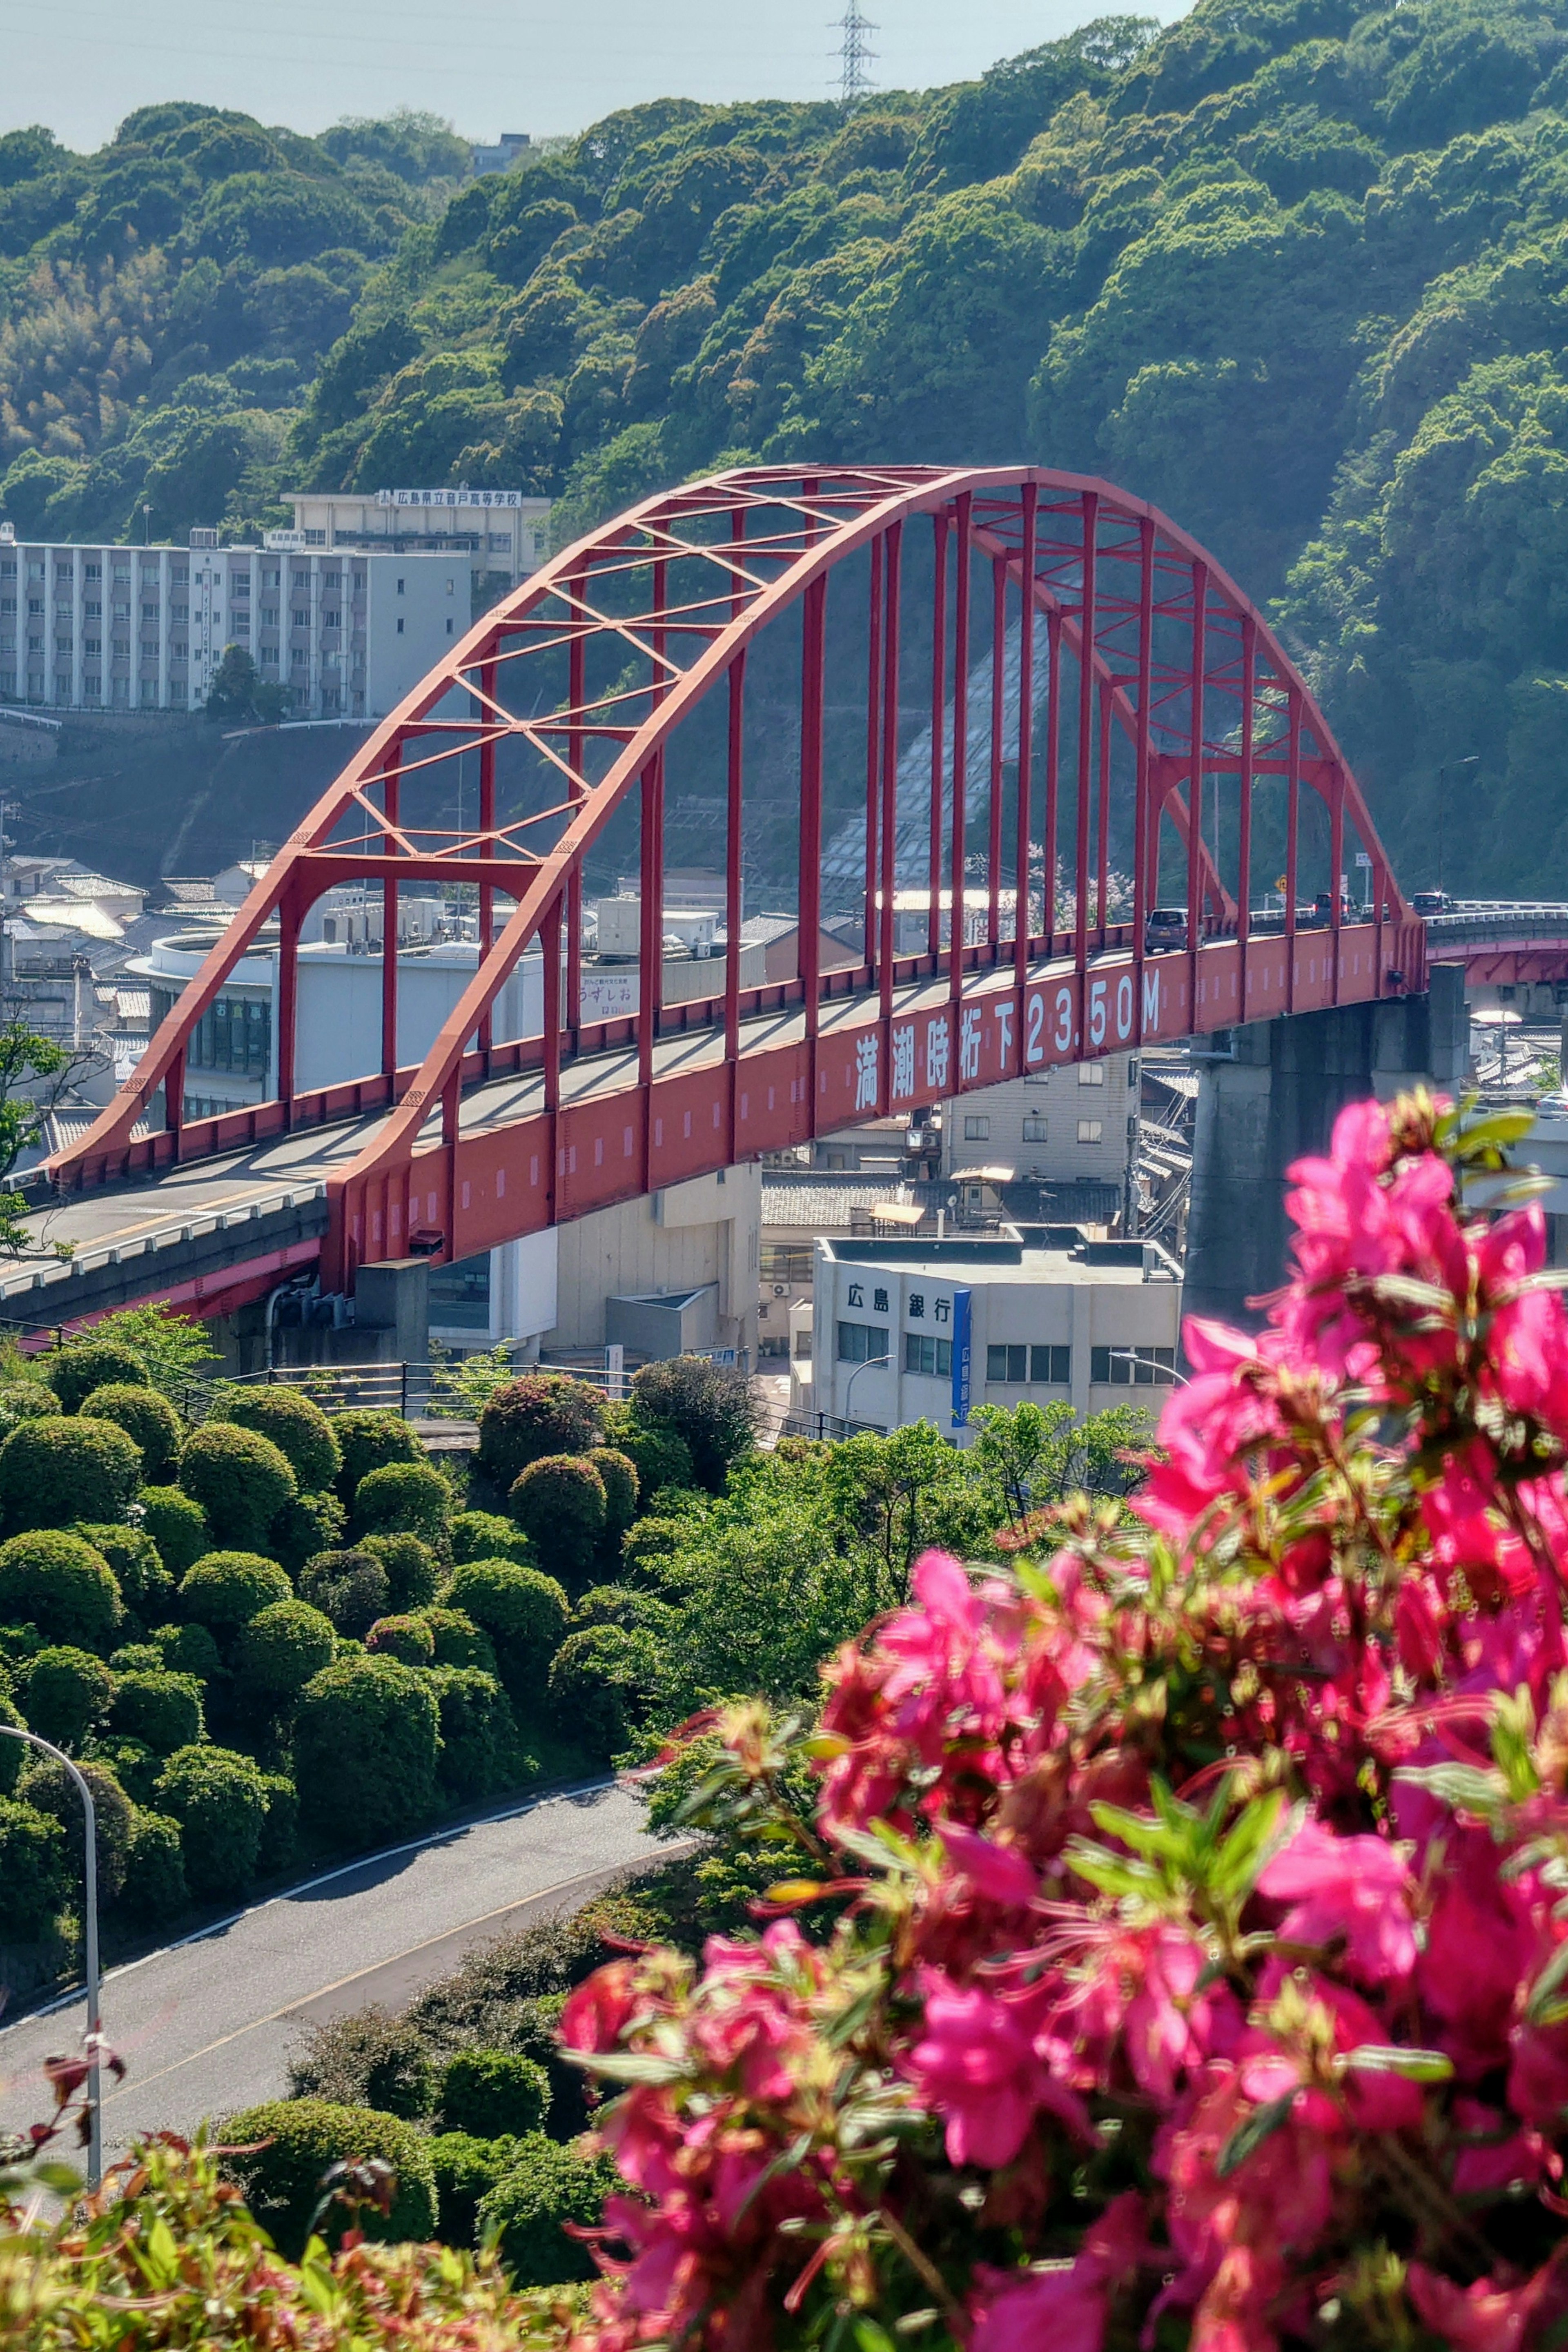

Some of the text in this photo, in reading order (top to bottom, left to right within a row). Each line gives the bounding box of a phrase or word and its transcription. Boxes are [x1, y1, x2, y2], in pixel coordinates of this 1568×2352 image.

[398, 491, 517, 506] 広島県立音戸高等学校
[579, 987, 631, 1003] うずしお
[855, 968, 1160, 1111] 満潮時桁下23.50M
[848, 1283, 951, 1322] 広島銀行
